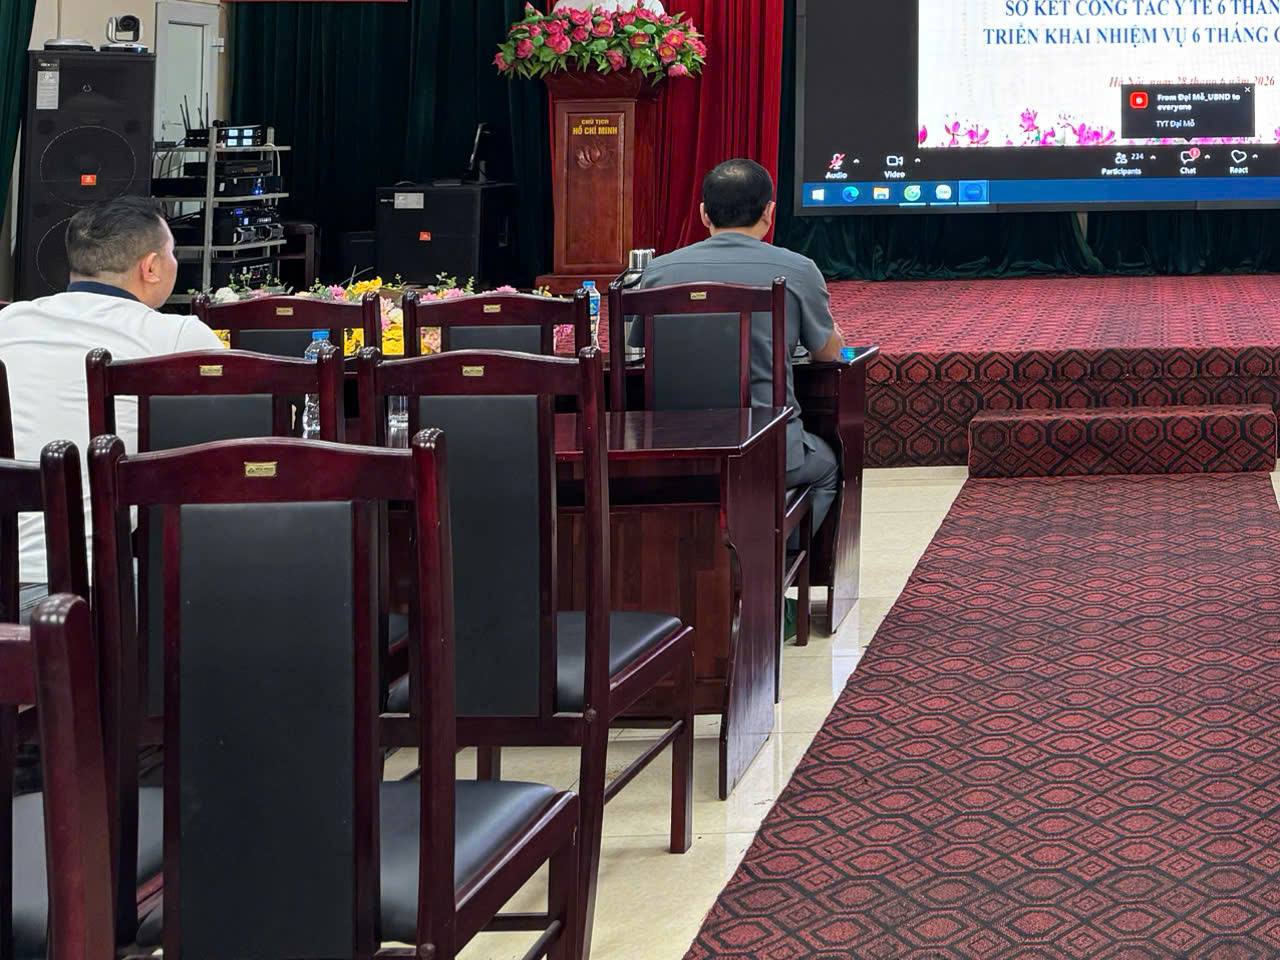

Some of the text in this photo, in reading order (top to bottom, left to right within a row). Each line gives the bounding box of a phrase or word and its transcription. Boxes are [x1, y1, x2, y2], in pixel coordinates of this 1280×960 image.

[1175, 0, 1189, 15] Y
[1218, 0, 1226, 14] 6
[983, 24, 1038, 44] TRIỂN
[1045, 28, 1090, 44] KHAI
[1096, 27, 1159, 48] NHIỆM
[1162, 27, 1186, 47] VỤ
[1192, 27, 1200, 43] 6
[1205, 23, 1267, 43] THÁNG
[1157, 104, 1192, 112] everyone
[584, 126, 596, 134] CHÍ
[1102, 167, 1141, 175] Participants
[1180, 167, 1196, 175] Chat
